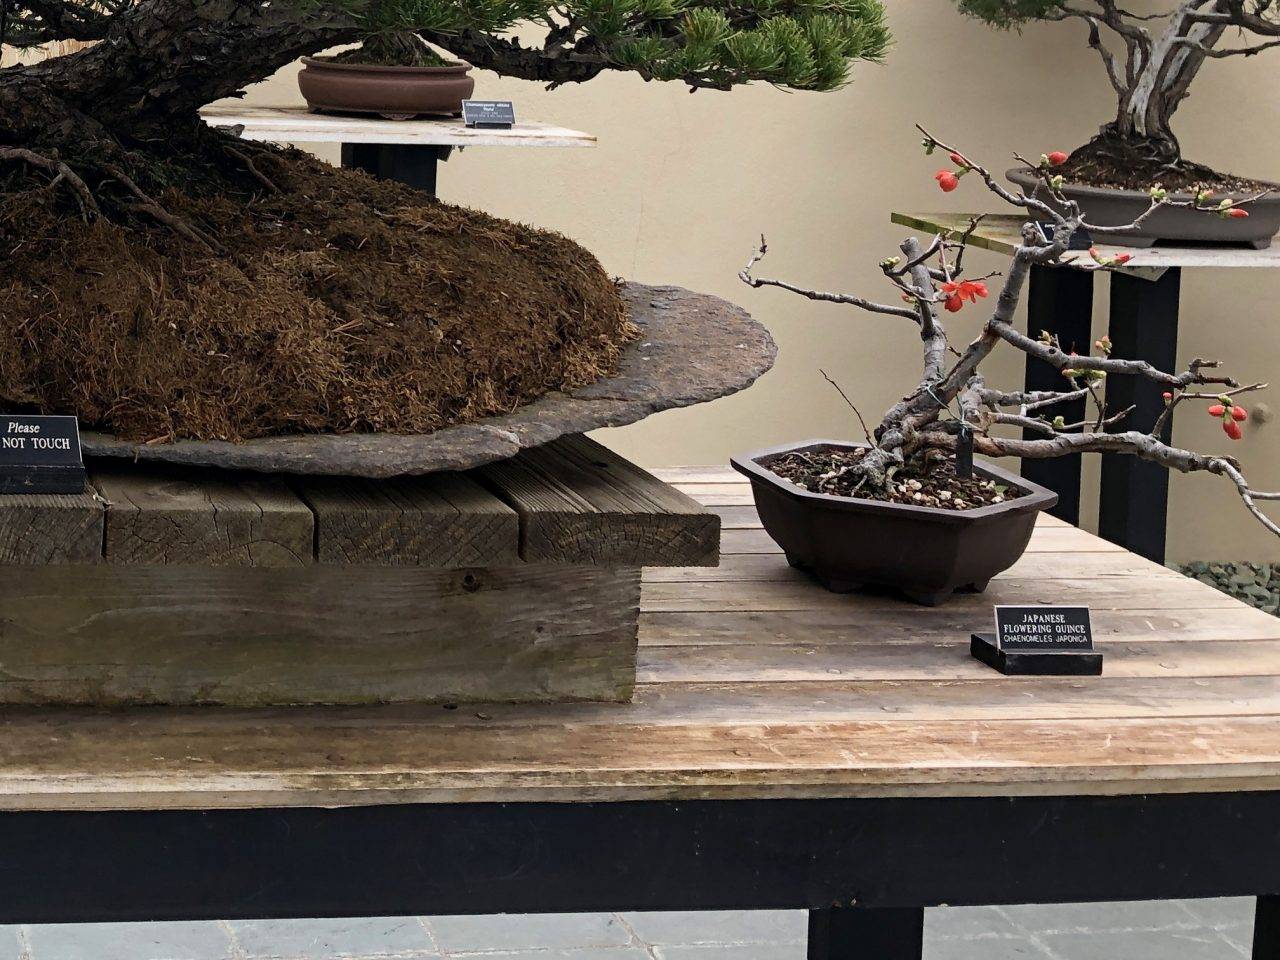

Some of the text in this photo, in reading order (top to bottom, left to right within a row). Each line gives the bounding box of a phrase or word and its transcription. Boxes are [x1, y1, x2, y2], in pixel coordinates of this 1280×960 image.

[8, 422, 40, 433] Please
[2, 438, 25, 448] NOT
[31, 438, 70, 449] TOUCH
[1023, 614, 1065, 623] JAPANESE
[1004, 625, 1085, 633] FLOWERING QUINCE
